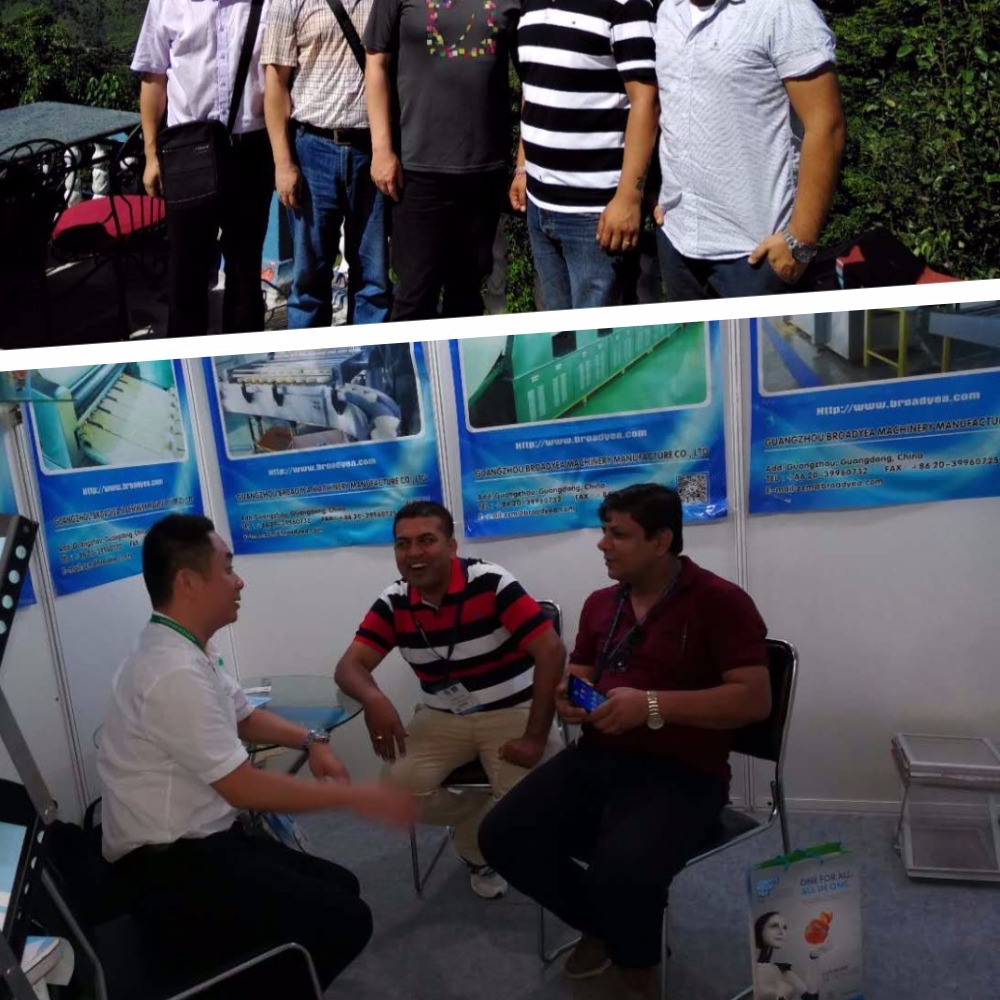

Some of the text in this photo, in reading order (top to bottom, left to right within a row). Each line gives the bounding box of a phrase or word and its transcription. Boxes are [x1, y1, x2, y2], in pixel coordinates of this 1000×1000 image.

[765, 414, 1000, 447] GUANGZHOU BROADYEA MACHINERY MANUFACTU
[475, 464, 525, 478] GUANGZHOU
[613, 449, 674, 465] MANUFACTURE
